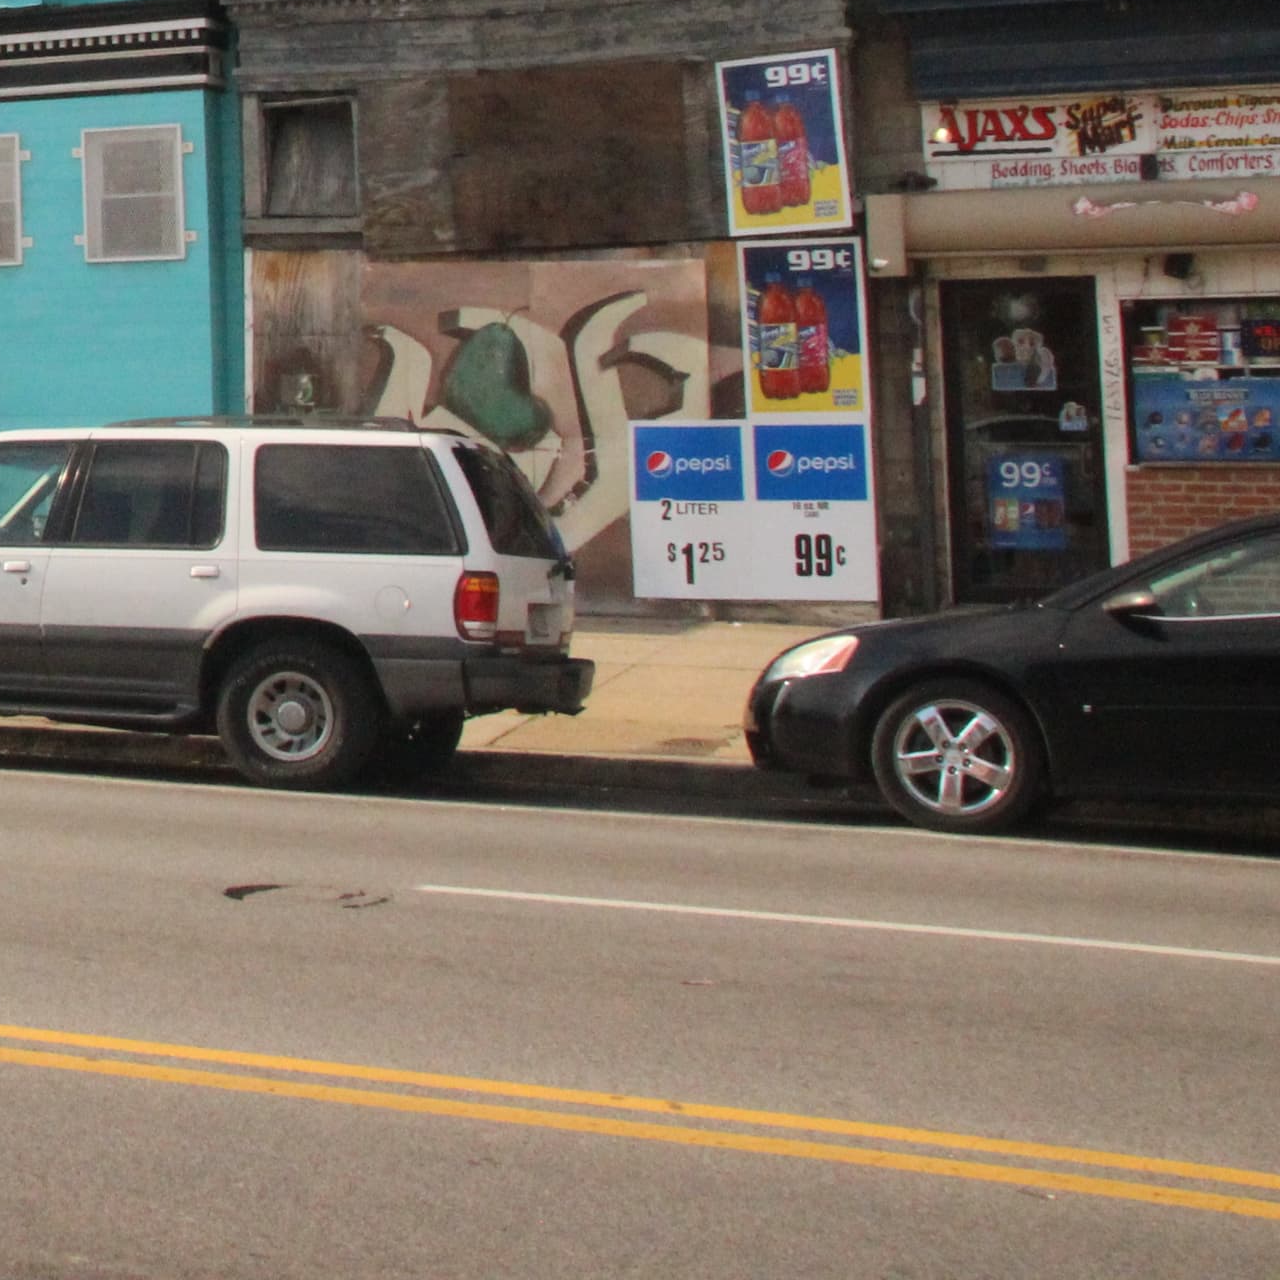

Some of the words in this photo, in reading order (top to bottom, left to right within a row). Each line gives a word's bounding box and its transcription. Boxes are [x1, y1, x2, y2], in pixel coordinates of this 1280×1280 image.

[765, 62, 827, 88] 99¢
[787, 249, 851, 271] 99¢
[675, 454, 731, 475] pepsi
[797, 454, 855, 474] pepsi
[661, 499, 673, 521] 2
[676, 502, 719, 516] LITER
